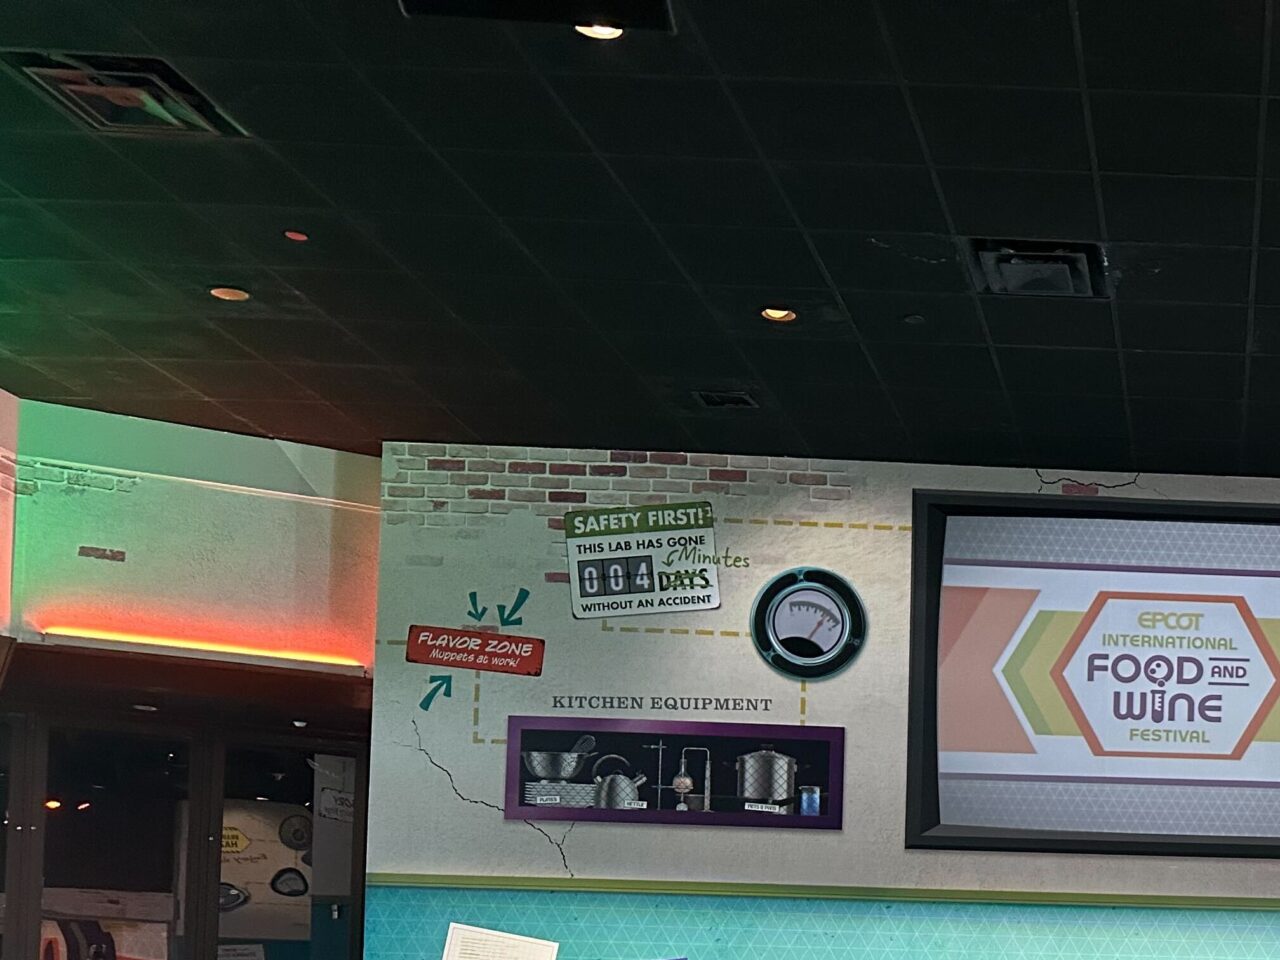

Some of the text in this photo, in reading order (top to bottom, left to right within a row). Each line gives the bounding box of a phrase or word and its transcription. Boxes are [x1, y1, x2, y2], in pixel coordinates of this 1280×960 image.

[574, 508, 703, 534] SAFETY FIRST!
[576, 535, 706, 554] THIS LAB HAS GONE
[678, 546, 750, 568] Minutes
[584, 562, 710, 593] 004 DAYS
[581, 594, 712, 612] WITHOUT AN ACCIDENT
[1138, 611, 1204, 631] EPCOT
[418, 632, 533, 656] FLAVOR ZONE
[1102, 634, 1238, 650] INTERNATIONAL
[429, 649, 521, 667] Muppets at work!
[1087, 653, 1247, 686] FOOD AND
[552, 696, 773, 712] KITCHEN EQUIPMENT
[1113, 690, 1222, 723] WINE
[1130, 728, 1210, 743] FESTIVAL
